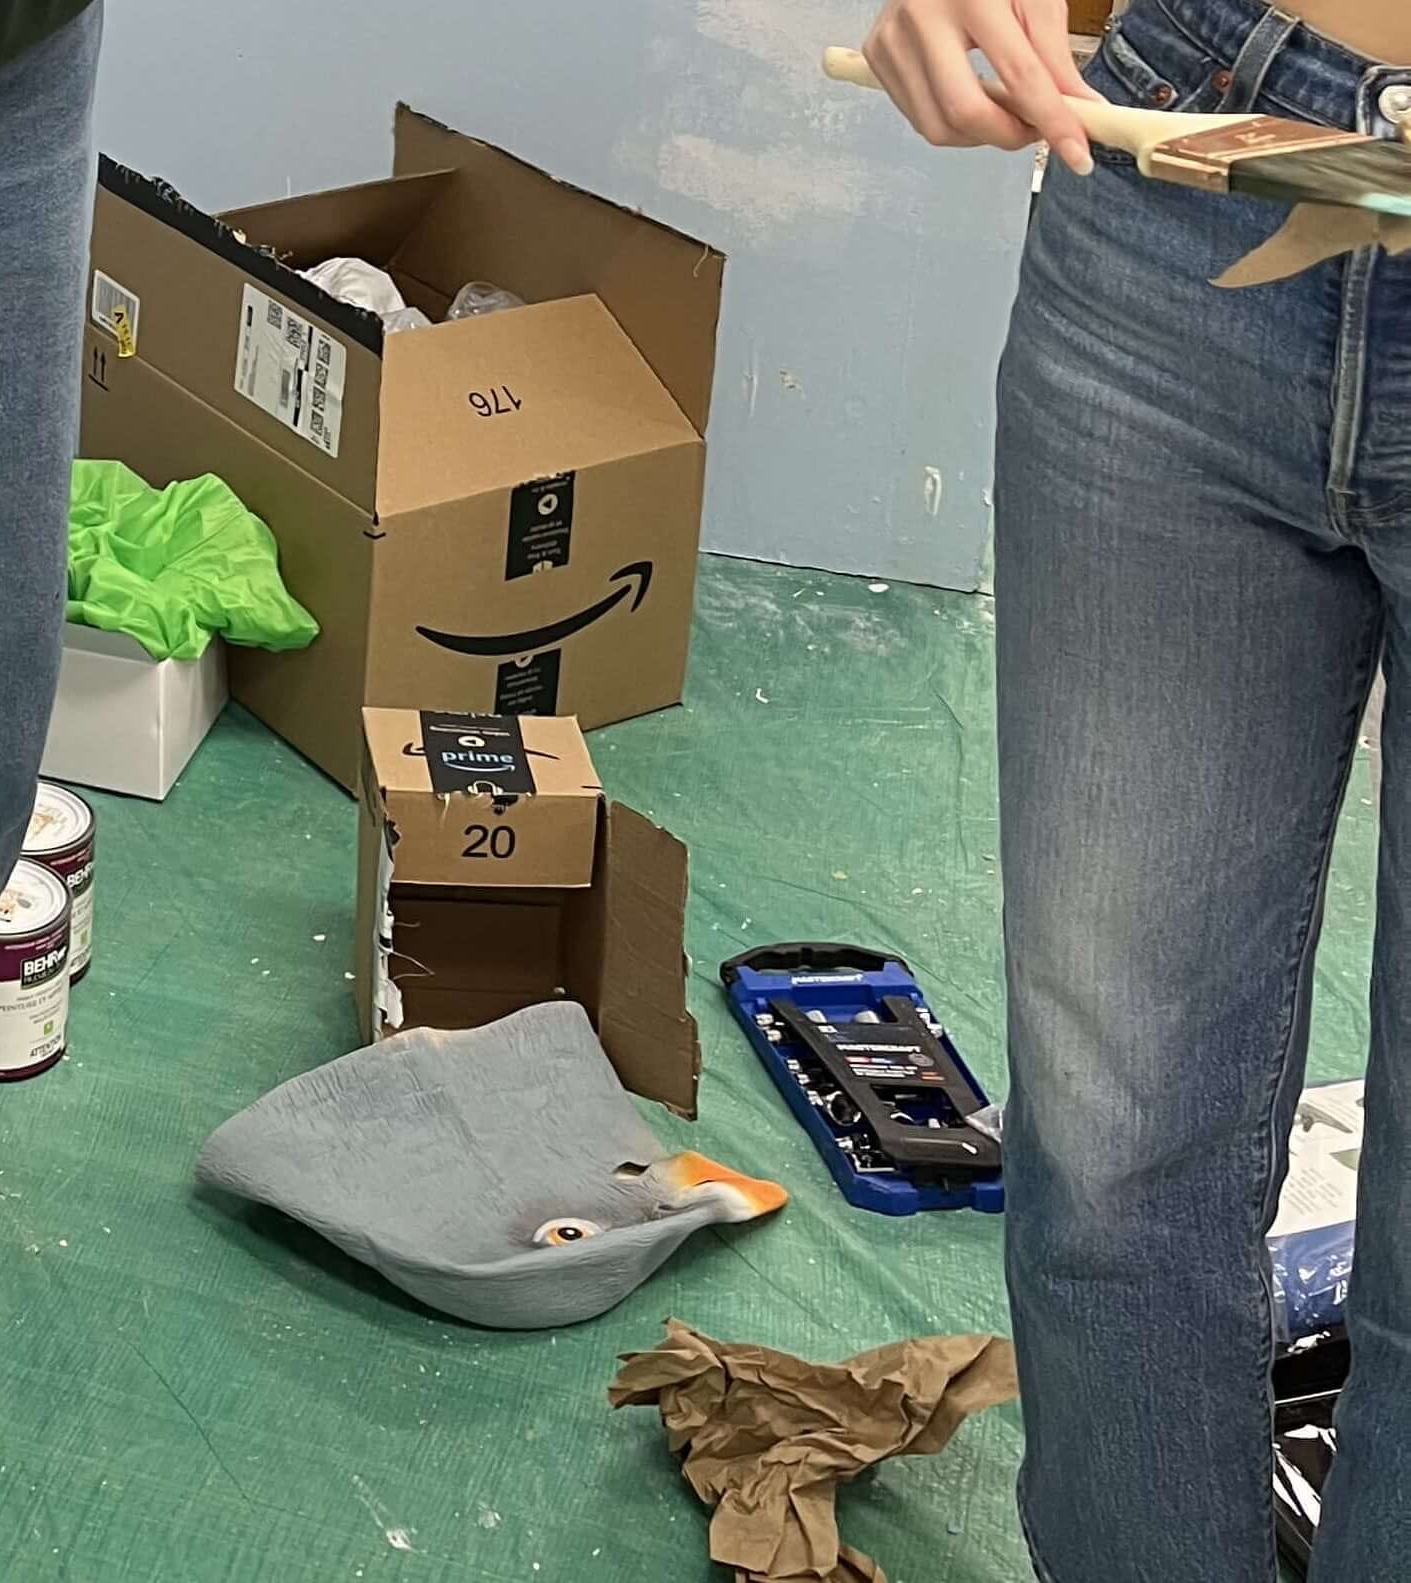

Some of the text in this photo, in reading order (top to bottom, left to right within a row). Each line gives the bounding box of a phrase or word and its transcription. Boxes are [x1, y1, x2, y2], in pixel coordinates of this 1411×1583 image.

[469, 386, 522, 417] 176
[441, 749, 515, 764] prime
[461, 824, 516, 859] 20
[24, 948, 62, 977] BEHR
